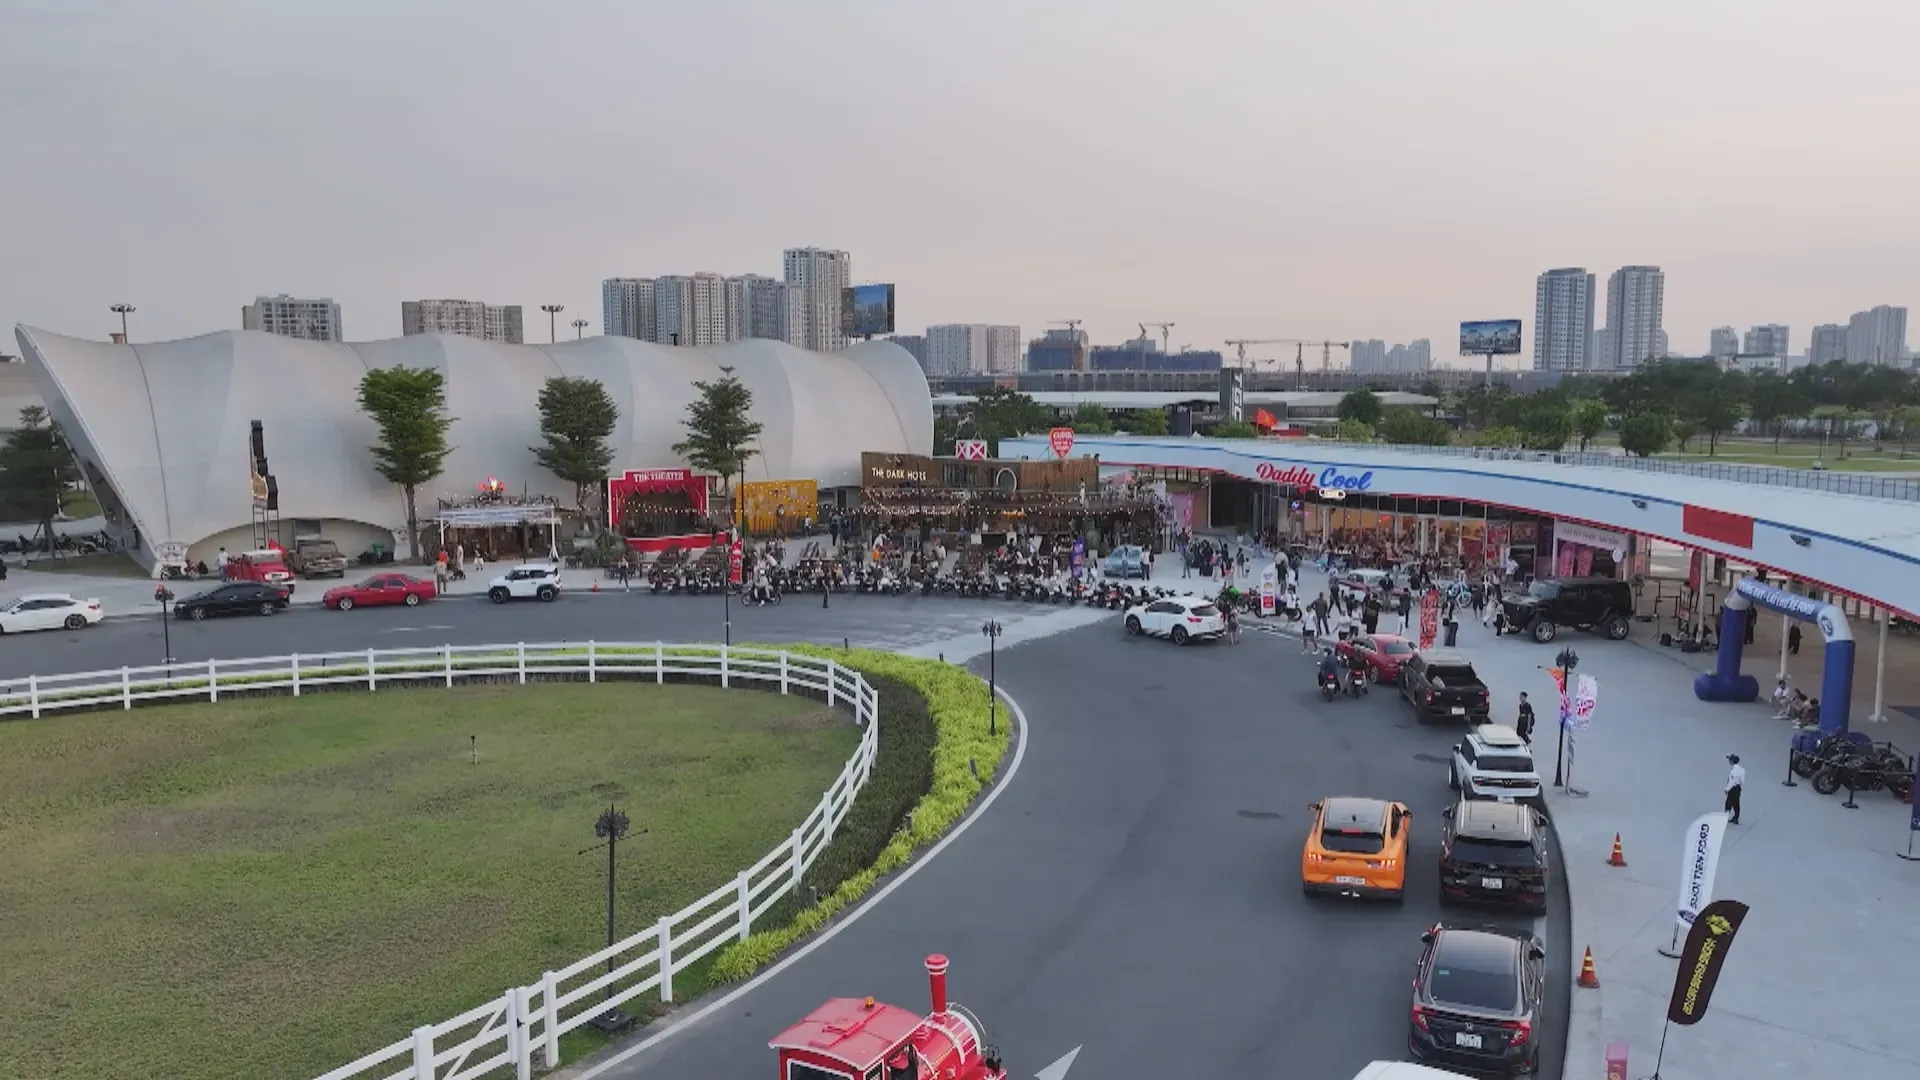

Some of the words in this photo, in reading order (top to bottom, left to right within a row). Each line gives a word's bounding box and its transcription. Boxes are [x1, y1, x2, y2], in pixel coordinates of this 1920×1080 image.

[633, 472, 650, 482] THE
[871, 467, 885, 479] THE
[886, 469, 905, 479] DARK
[1256, 462, 1316, 489] Daddy
[1320, 467, 1373, 490] Cool
